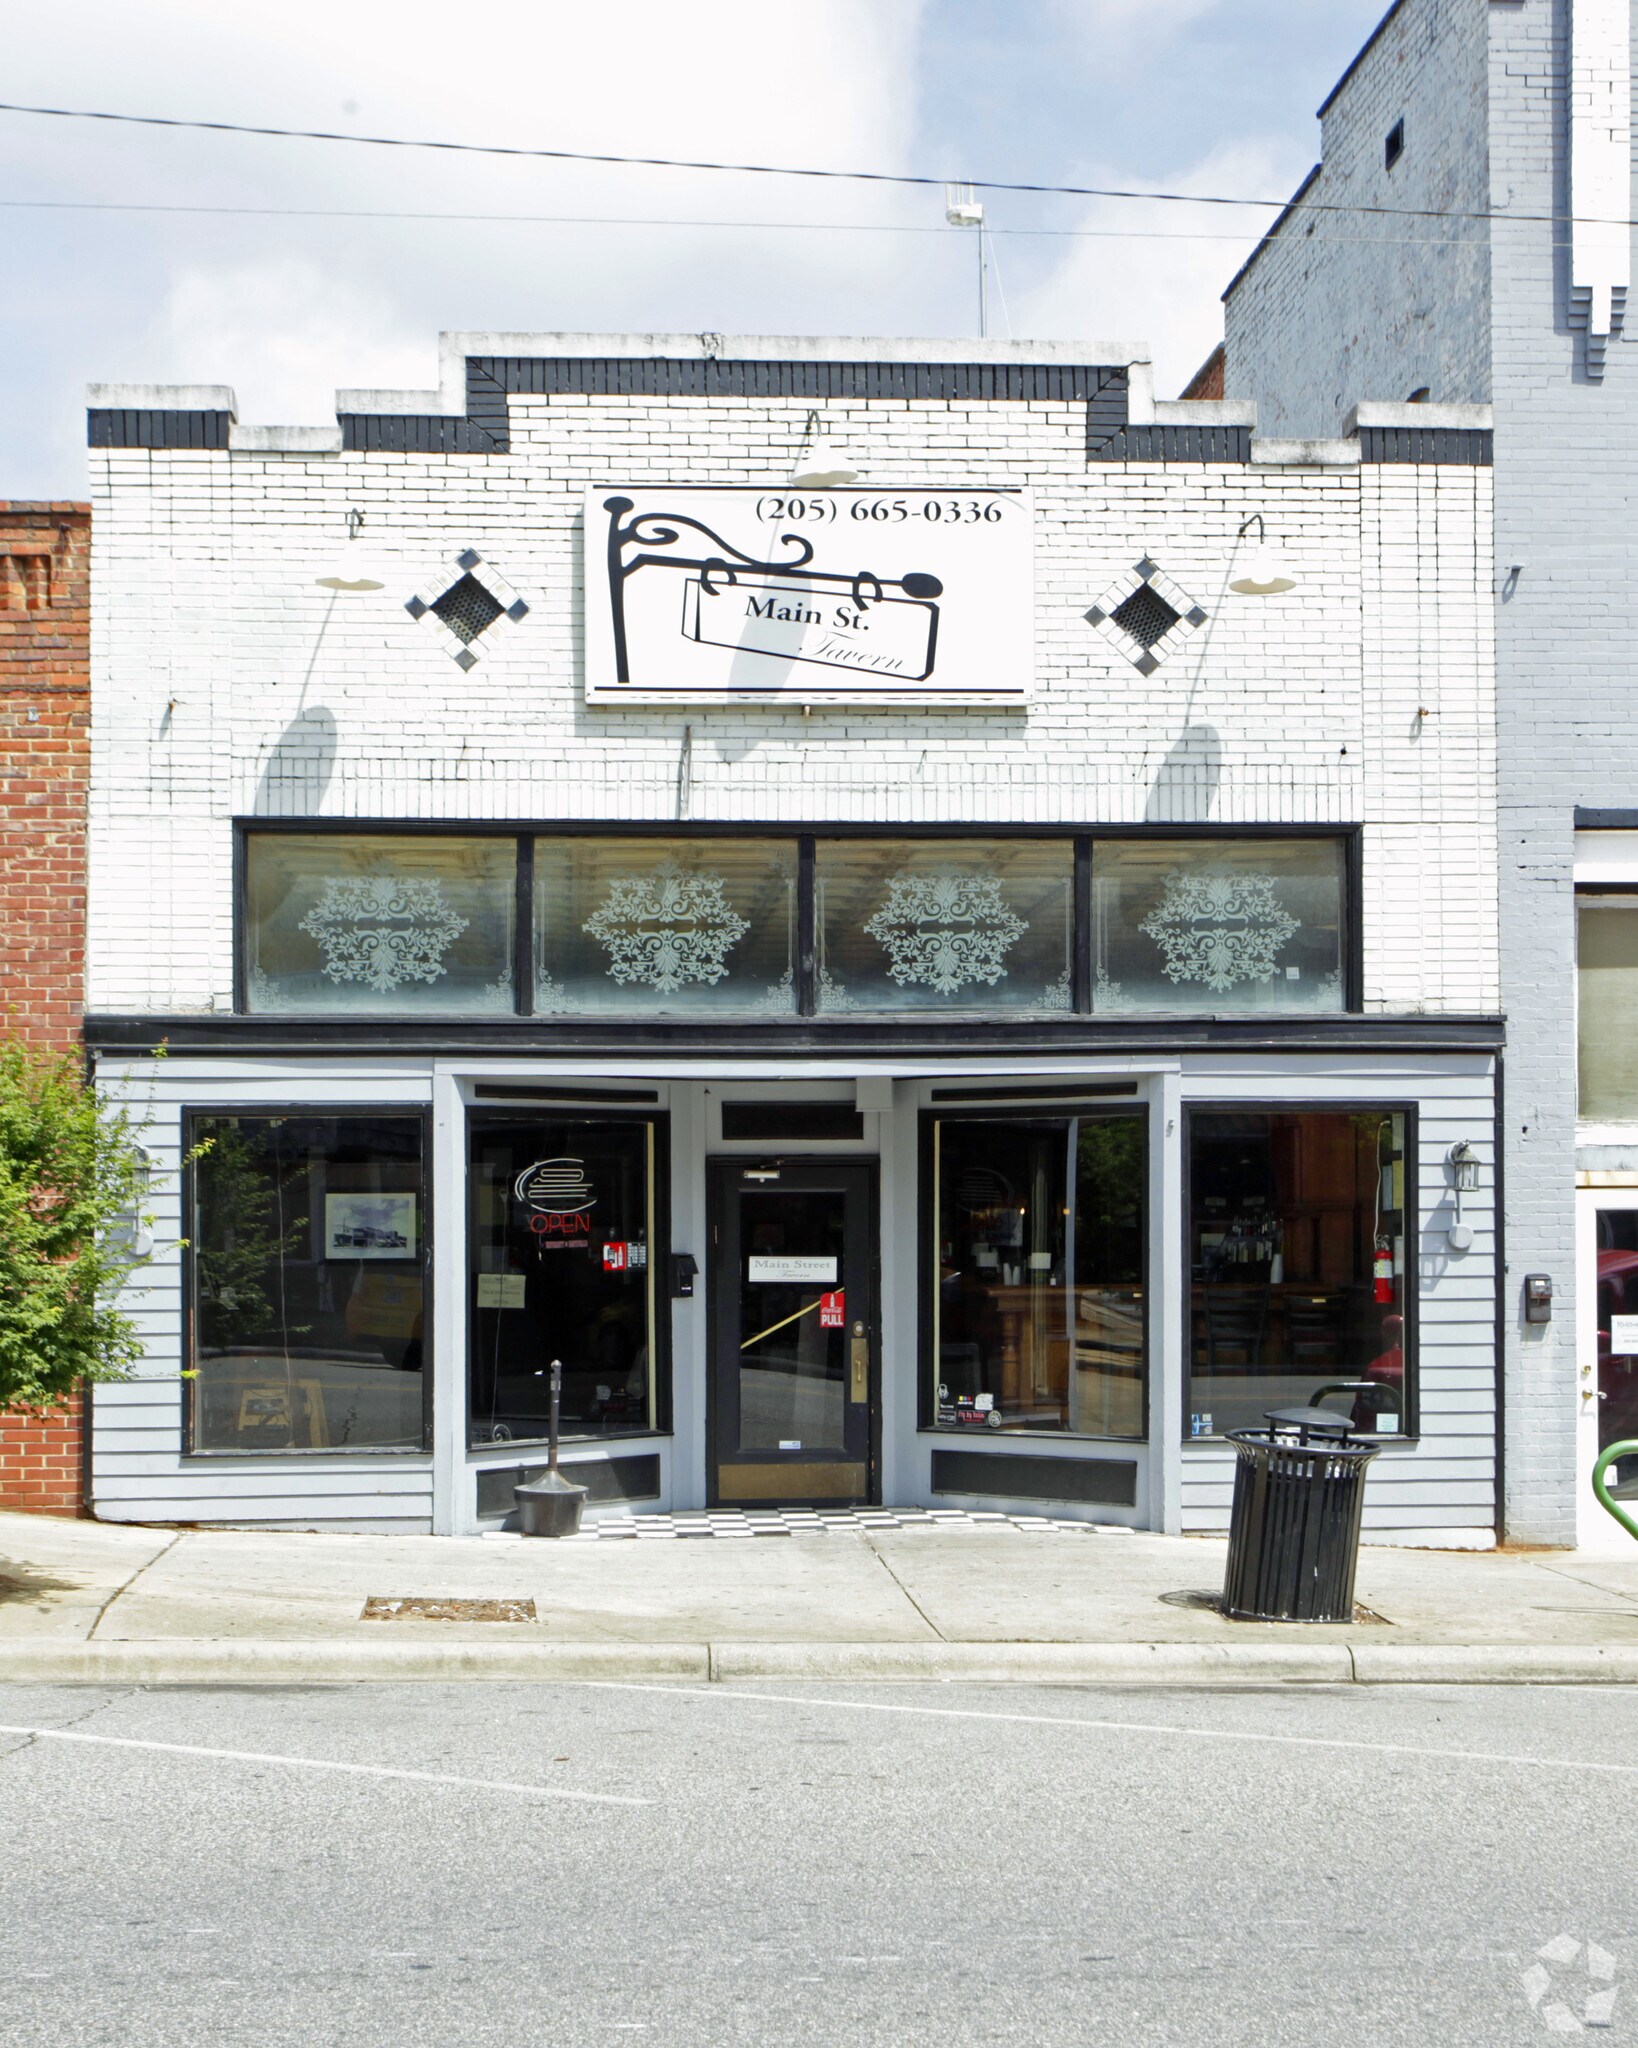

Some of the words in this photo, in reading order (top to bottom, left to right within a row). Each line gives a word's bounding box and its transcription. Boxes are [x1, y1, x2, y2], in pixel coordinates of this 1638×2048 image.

[756, 496, 837, 525] (205)
[850, 498, 1002, 524] 665-0336
[744, 595, 822, 625] Main
[833, 606, 869, 631] St.
[799, 628, 903, 670] Tavern
[529, 1213, 590, 1234] OPEN
[754, 1260, 790, 1269] Main
[794, 1260, 831, 1269] Street
[776, 1270, 810, 1278] Tavern
[821, 1314, 843, 1326] PULL
